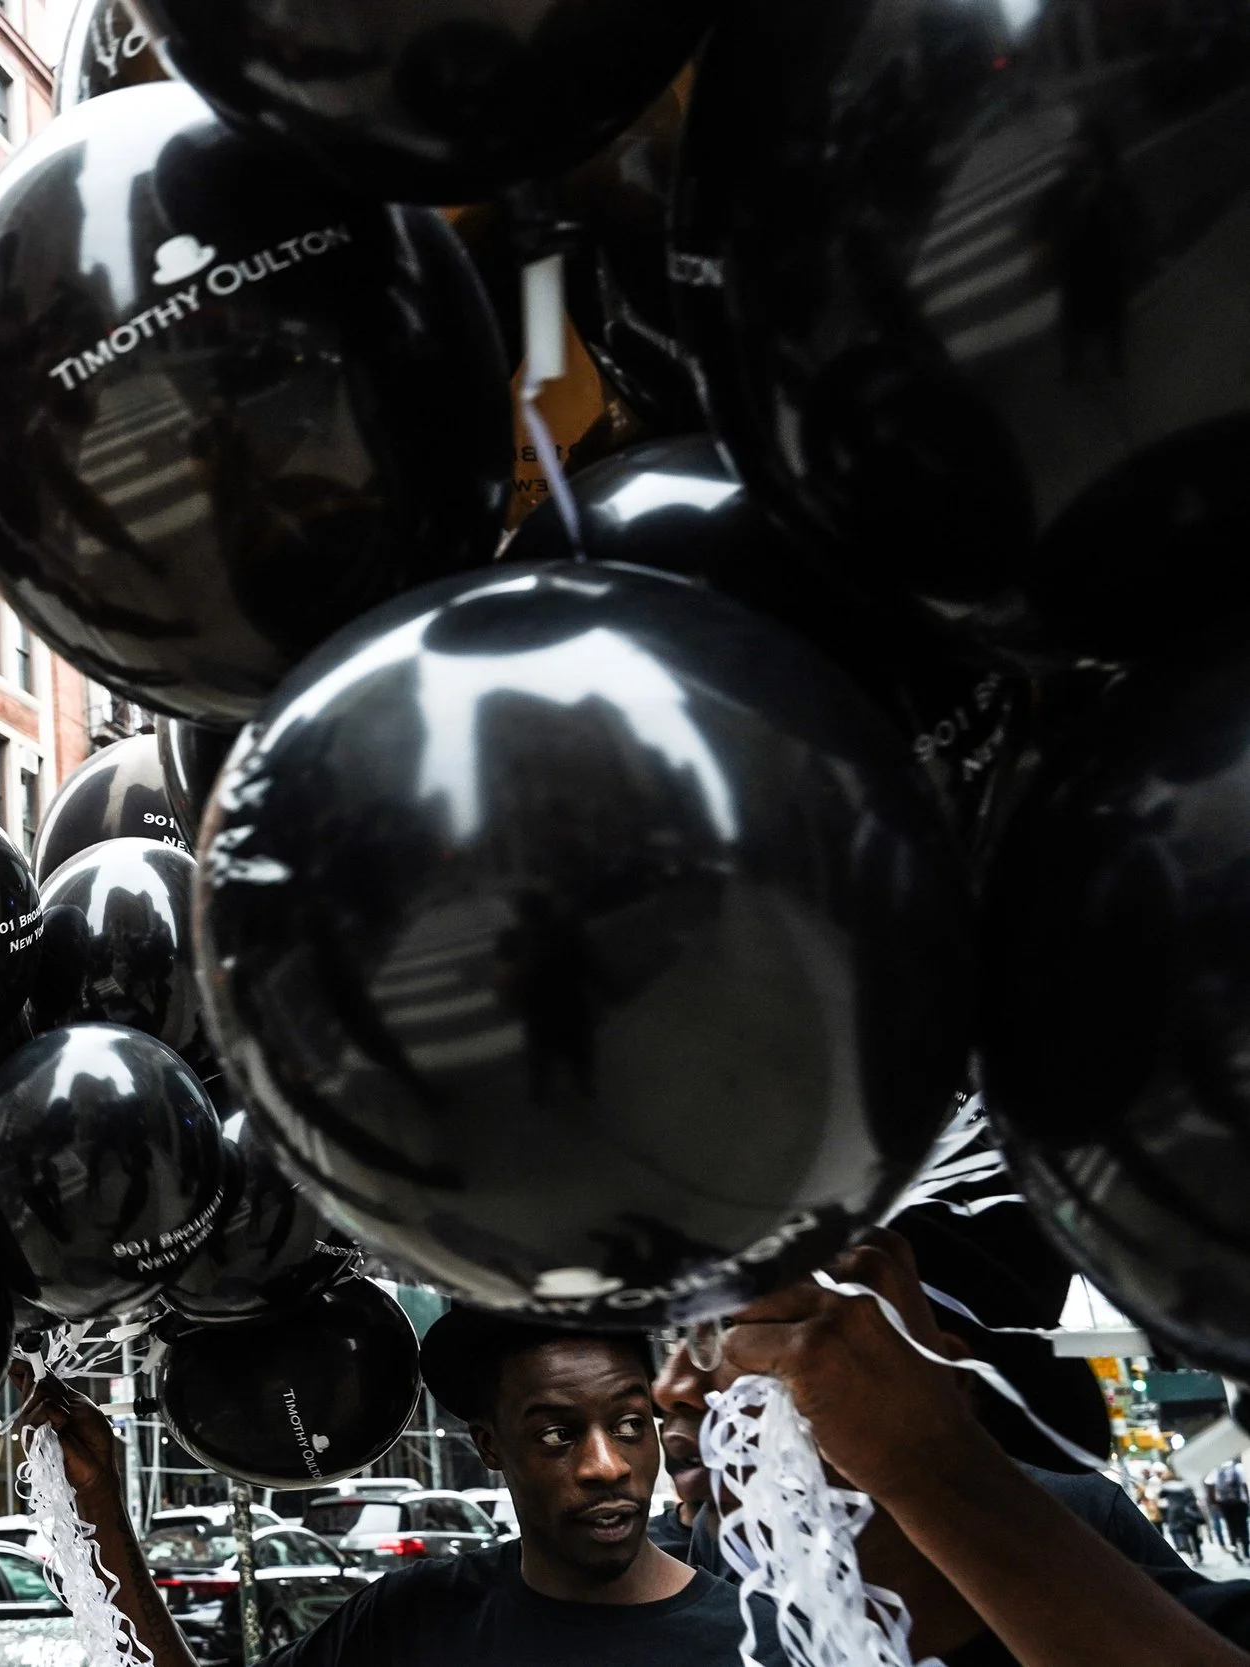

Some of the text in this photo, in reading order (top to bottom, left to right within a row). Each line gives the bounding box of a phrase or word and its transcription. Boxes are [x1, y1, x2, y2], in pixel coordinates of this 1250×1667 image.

[49, 285, 200, 390] TIMOTHY
[143, 812, 175, 829] 901
[163, 835, 190, 852] NE
[10, 934, 34, 953] NEW
[113, 1239, 150, 1258] 901
[283, 1388, 310, 1448] TIMOTHY
